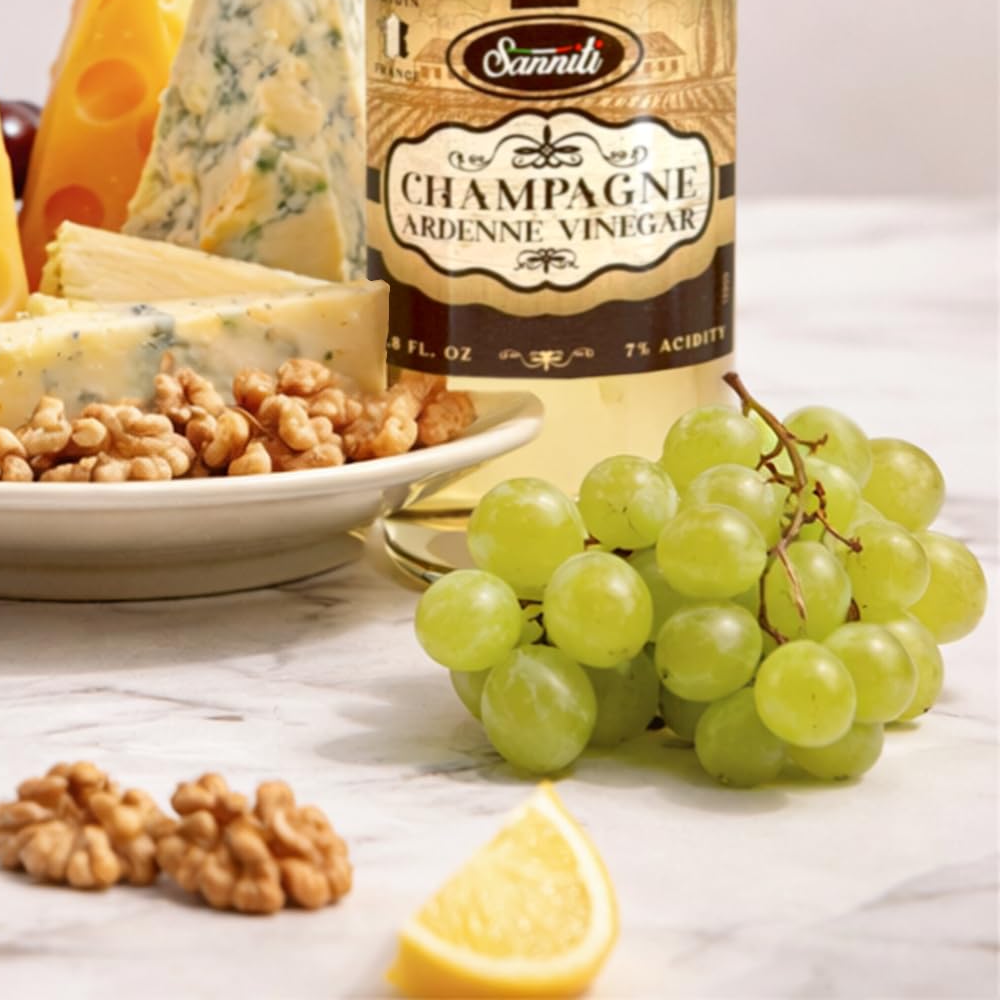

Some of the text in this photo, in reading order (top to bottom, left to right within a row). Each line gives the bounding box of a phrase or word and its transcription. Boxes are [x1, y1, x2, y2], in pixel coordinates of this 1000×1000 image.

[482, 35, 604, 78] Sanniti
[400, 165, 698, 212] CHAMPAGNE
[401, 208, 697, 244] ARDENNE VINEGAR
[408, 339, 436, 358] FL.
[443, 345, 473, 362] OZ
[624, 326, 726, 358] 7% ACIDITY
